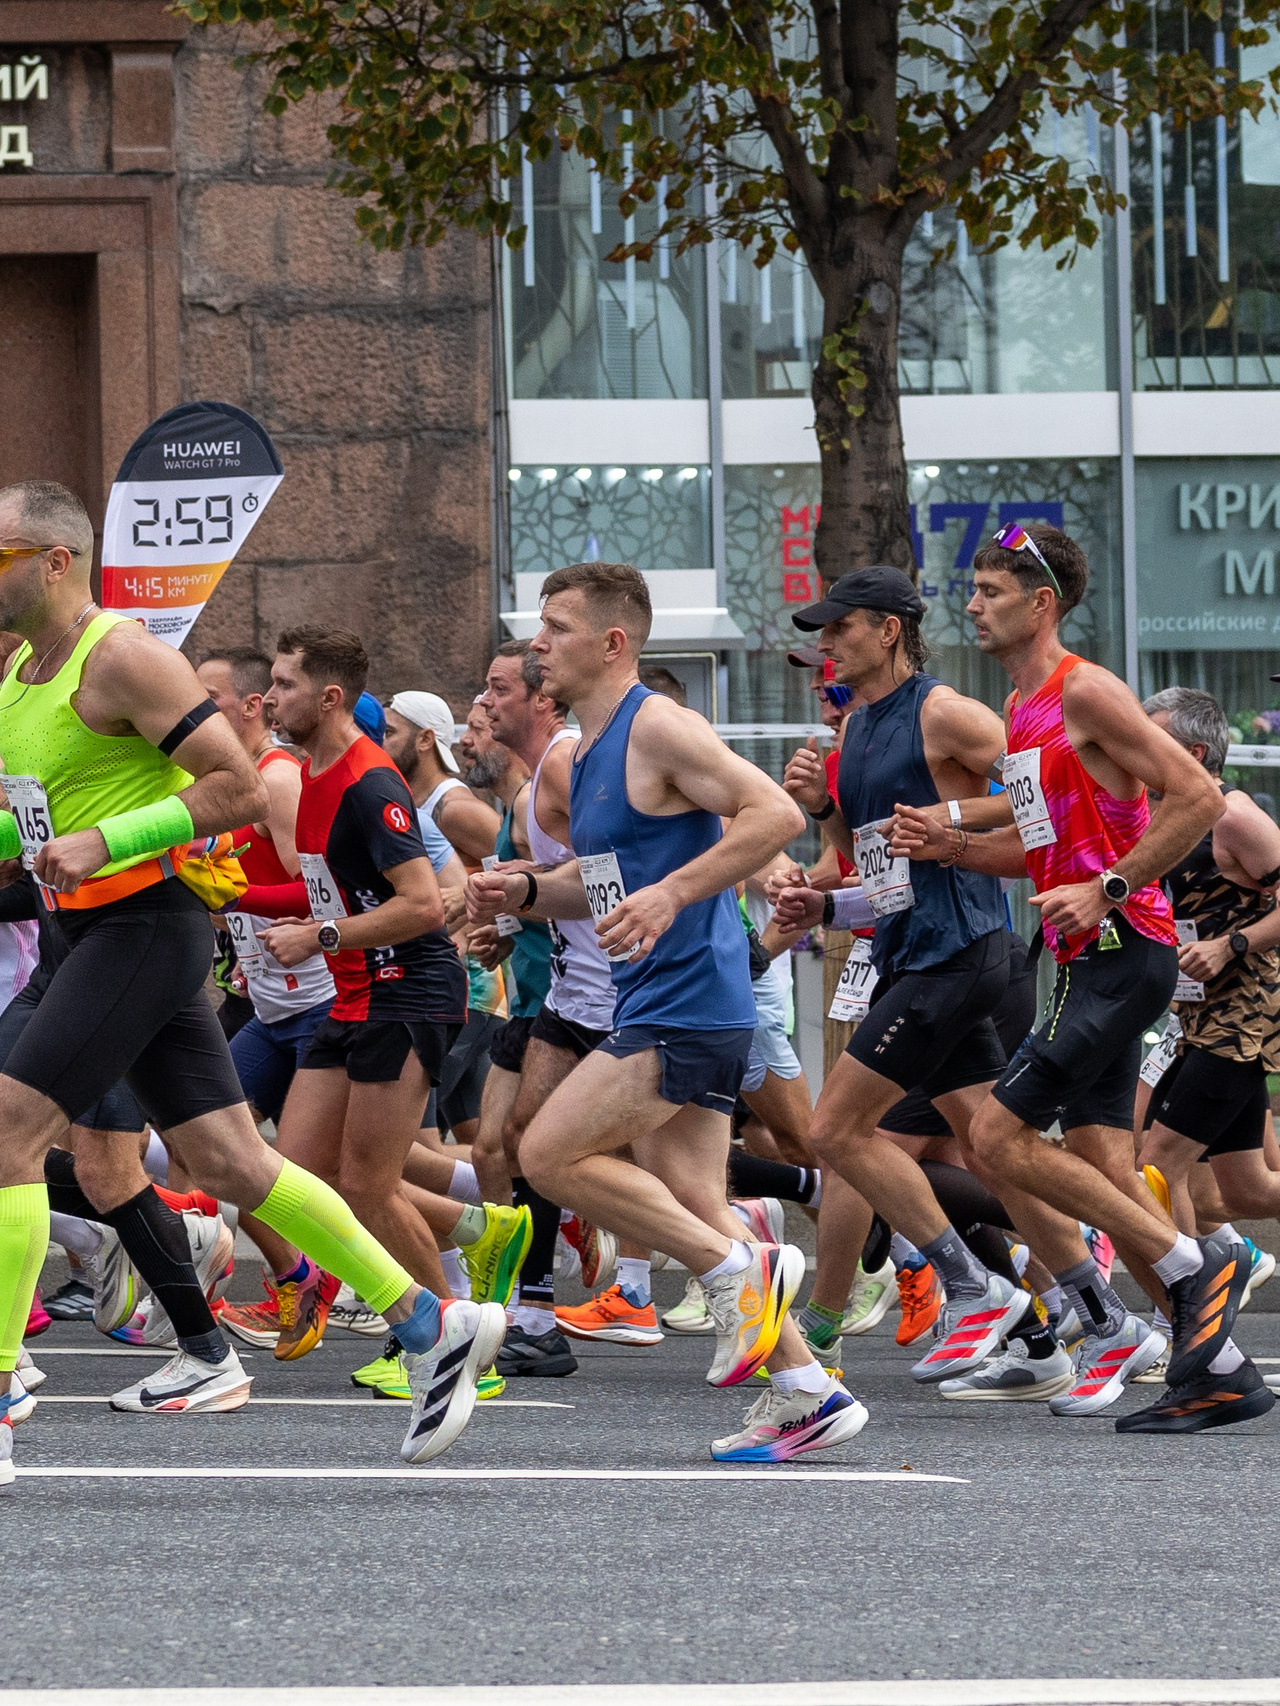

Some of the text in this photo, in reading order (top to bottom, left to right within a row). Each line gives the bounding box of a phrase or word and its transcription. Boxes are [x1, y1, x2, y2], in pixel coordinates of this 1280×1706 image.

[163, 441, 241, 458] HUAWEI
[164, 459, 199, 470] WATCH
[202, 459, 214, 469] GT
[225, 458, 241, 467] Pro
[133, 495, 232, 547] 2:59
[1225, 550, 1275, 595] М
[124, 574, 212, 599] 4:15 МИНУТ/
[168, 587, 186, 598] КМ
[1138, 611, 1266, 635] российские
[860, 843, 895, 879] 2029
[586, 881, 624, 915] 9093
